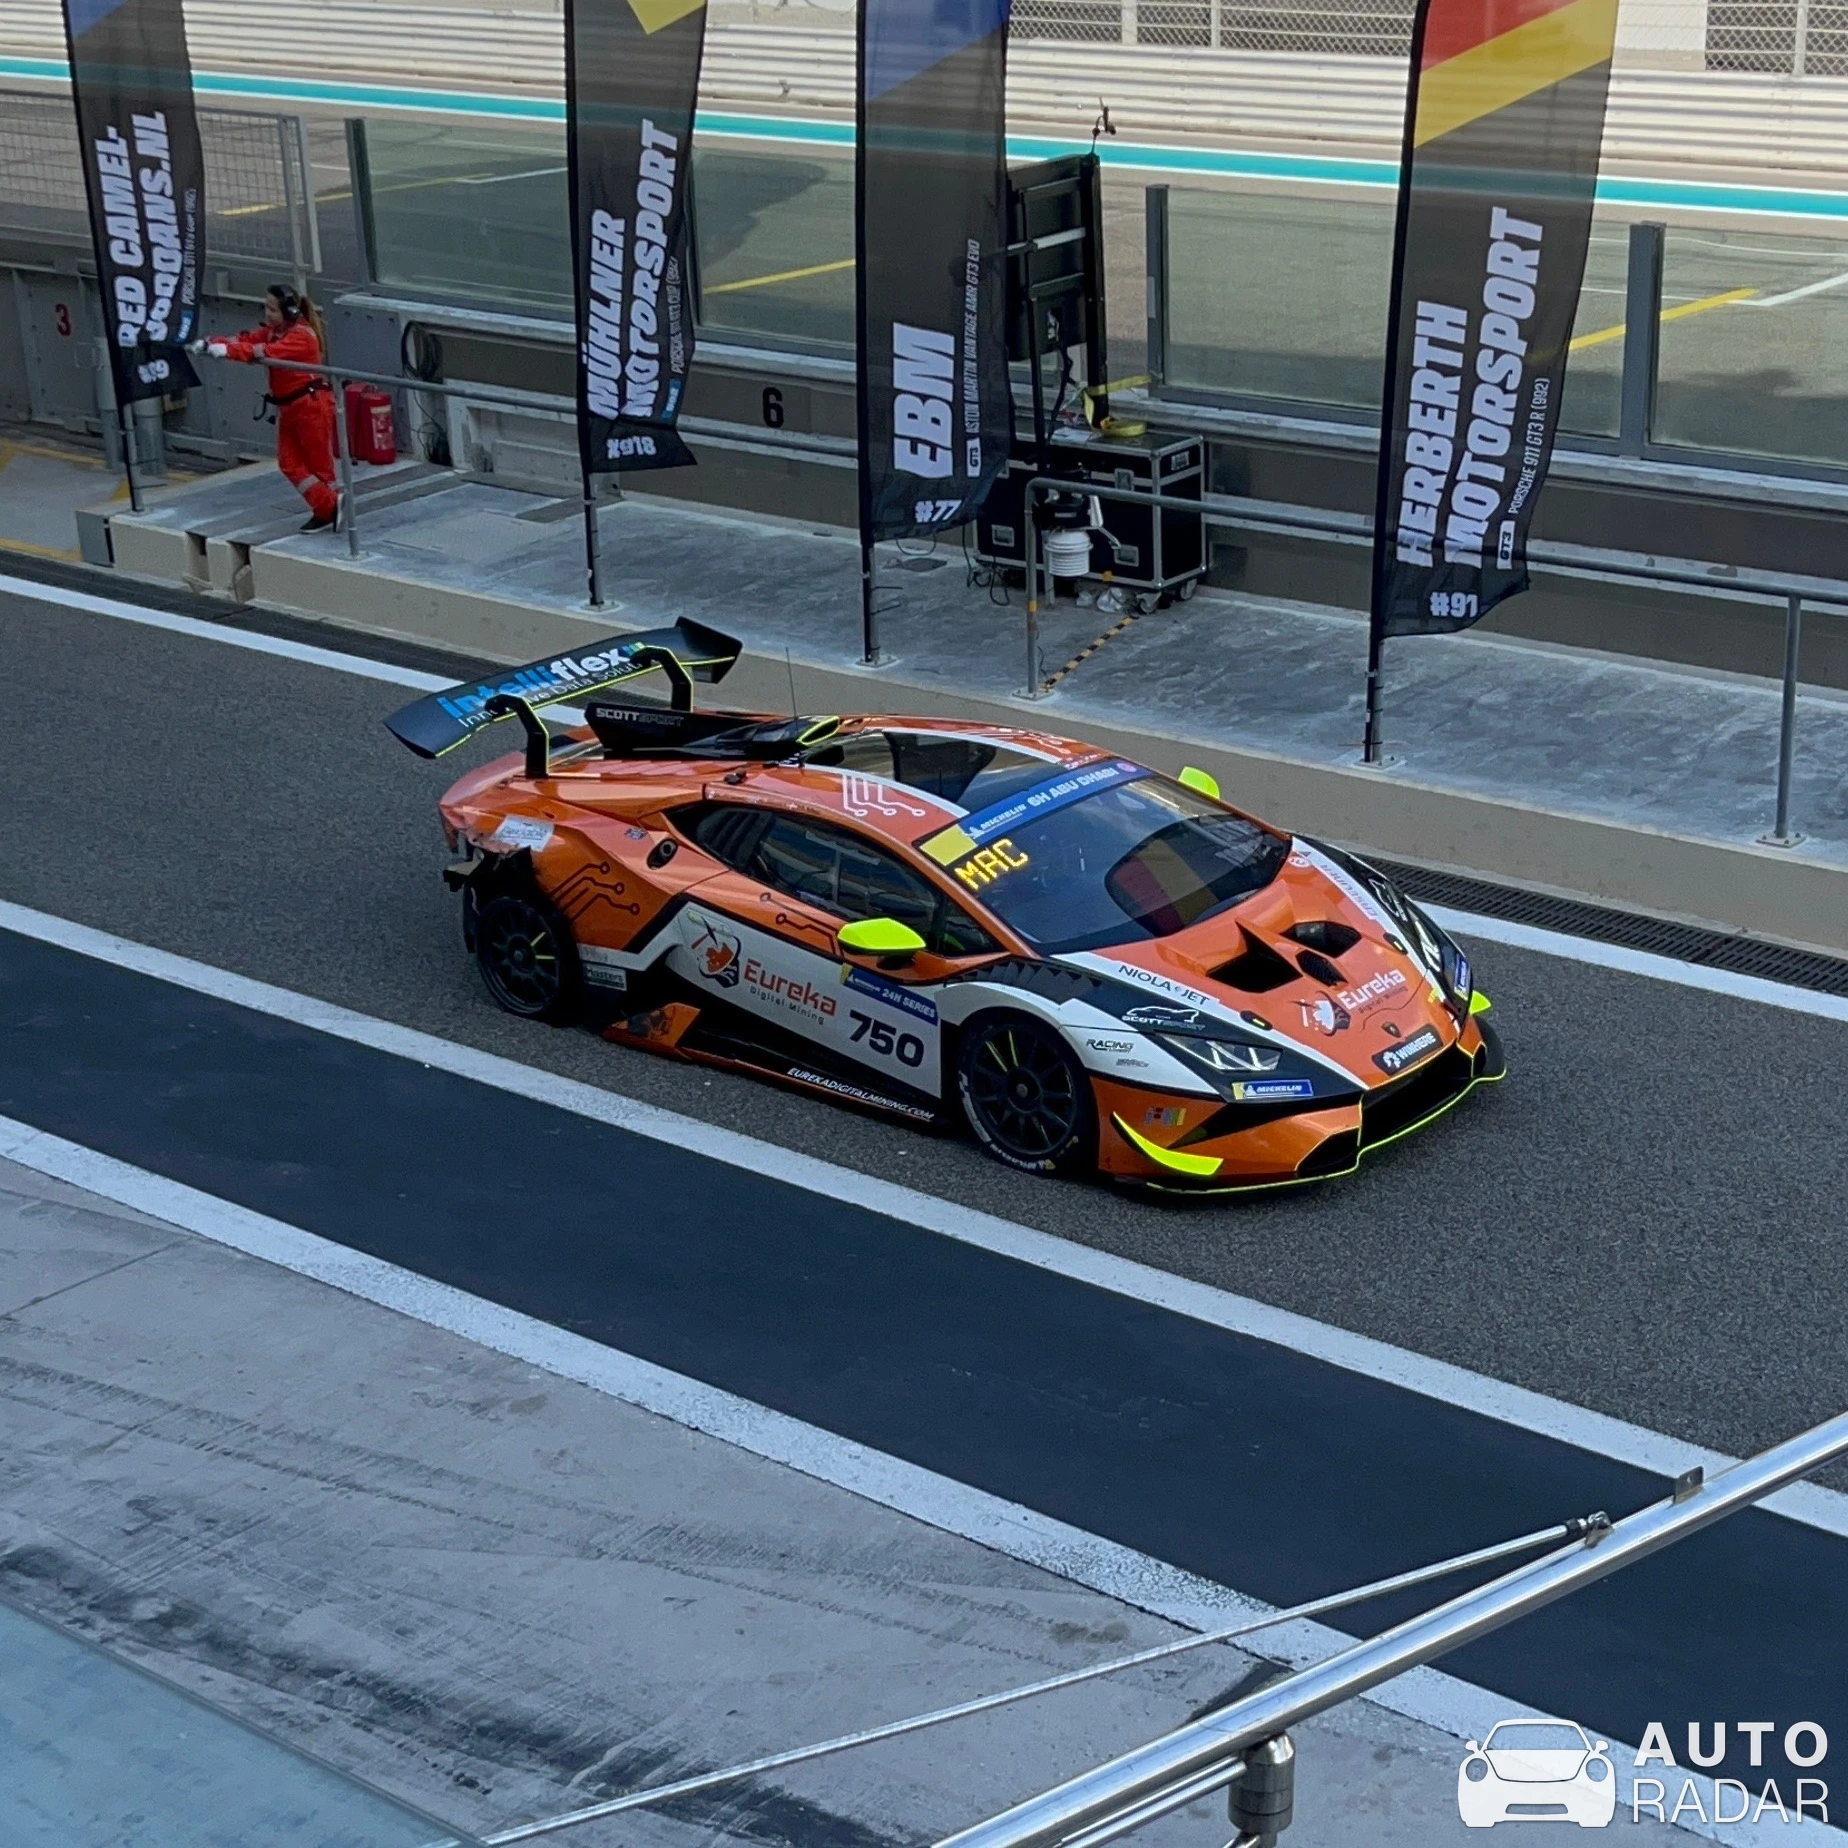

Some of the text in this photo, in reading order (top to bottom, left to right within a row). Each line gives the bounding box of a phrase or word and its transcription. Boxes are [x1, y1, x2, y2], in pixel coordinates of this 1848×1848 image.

[94, 124, 147, 348] RED CAMEL-
[966, 238, 981, 262] EVO
[620, 118, 678, 417] MOTORSPORT
[965, 262, 979, 285] GT3
[55, 303, 72, 337] 3
[581, 209, 626, 420] MÜHLNER
[964, 285, 979, 312] AMR
[963, 312, 979, 361] VANTAGE
[893, 321, 955, 479] EBM
[963, 360, 980, 403] MARTIN
[1443, 206, 1544, 570] MOTORSPORT
[762, 386, 785, 429] 6
[606, 435, 657, 460] #918
[1396, 300, 1469, 569] HERBERTH
[1499, 377, 1552, 561] GT3 PORSCHE 911 GT3 R (992)
[914, 499, 963, 523] #77
[1429, 591, 1479, 619] #91
[980, 803, 1027, 831] MICHELIN
[1048, 779, 1080, 799] ABU
[1075, 766, 1120, 787] DHABI
[953, 837, 1029, 891] MAC
[743, 957, 837, 1017] Eureka
[881, 987, 937, 1019] 24H SERIES
[1118, 964, 1211, 1006] NIOLA JET
[1336, 968, 1407, 1010] Eureka
[848, 1008, 925, 1068] 750
[786, 1066, 936, 1120] EUREKADIGITALMINING.COM
[1256, 1085, 1303, 1093] MICHELIN
